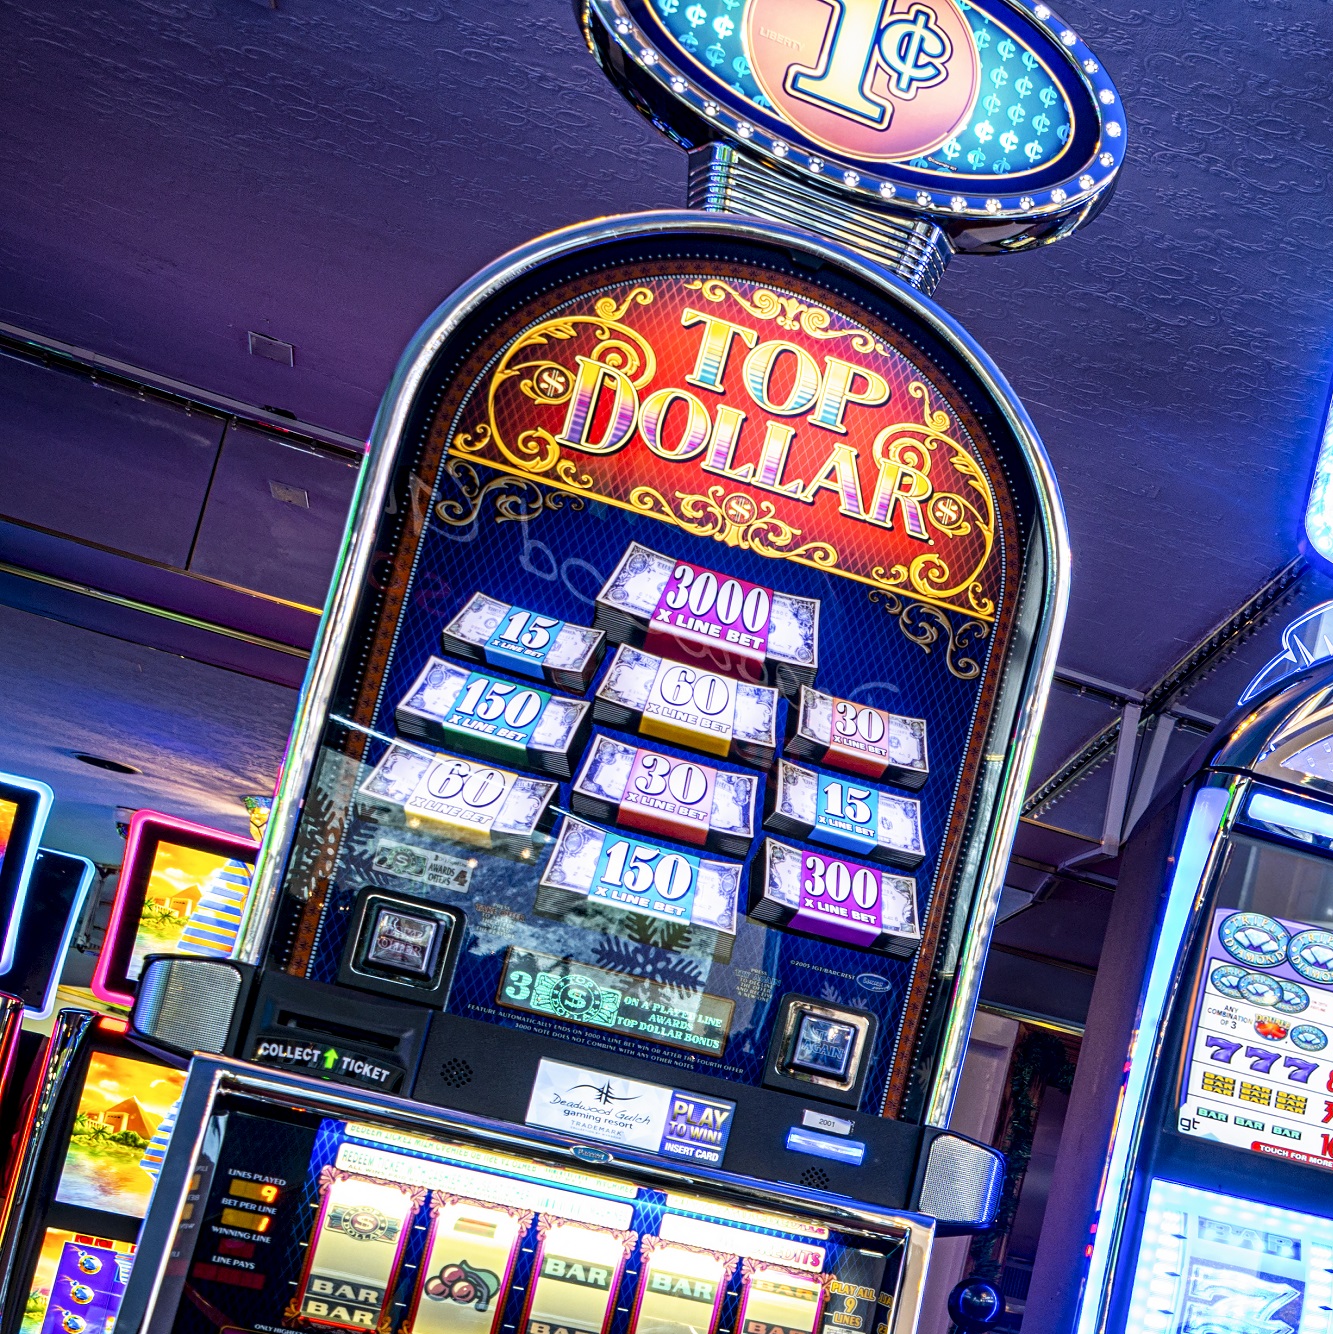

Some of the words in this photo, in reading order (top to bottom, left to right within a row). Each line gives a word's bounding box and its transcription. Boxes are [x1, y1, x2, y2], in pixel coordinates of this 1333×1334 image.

[681, 308, 890, 433] TOP
[555, 355, 933, 539] DOLLAR
[666, 564, 770, 632] 3000
[499, 611, 559, 649] 15
[655, 608, 669, 621] X
[675, 615, 720, 638] LINE
[725, 626, 764, 650] BET
[455, 678, 542, 728] 150
[660, 665, 728, 715] 60
[835, 702, 884, 742] 30
[427, 760, 505, 807] 60
[634, 754, 708, 803] 30
[823, 781, 871, 822] 15
[600, 840, 693, 899] 150
[804, 856, 879, 909] 300
[506, 970, 533, 1000] 3
[624, 997, 639, 1006] ON
[641, 1000, 649, 1009] A
[652, 1003, 698, 1022] PLAYED
[699, 1014, 722, 1028] LINE
[649, 1014, 693, 1031] AWARDS
[534, 1027, 550, 1035] NOTE
[552, 1031, 570, 1040] DOES
[571, 1035, 585, 1043] NOT
[587, 1039, 617, 1052] COMBINE
[618, 1046, 635, 1055] WITH
[636, 1050, 649, 1059] ANY
[650, 1054, 672, 1065] OTHER
[674, 1059, 694, 1070] NOTES
[618, 1017, 636, 1030] TOP
[638, 1021, 682, 1040] DOLLAR
[684, 1034, 720, 1049] BONUS
[260, 1043, 321, 1063] COLLECT
[342, 1056, 390, 1082] TICKET
[550, 1092, 613, 1116] Deadwood
[615, 1109, 651, 1125] Gulch
[563, 1108, 601, 1125] gaming
[604, 1118, 633, 1129] resort
[672, 1100, 729, 1130] PLAY
[819, 1119, 835, 1127] 2001
[571, 1120, 622, 1136] TRADEMARK
[669, 1121, 685, 1137] TO
[690, 1126, 722, 1144] WIN!
[664, 1143, 694, 1157] INSERT
[695, 1150, 719, 1161] CARD
[1260, 1144, 1288, 1157] TOUCH
[1290, 1152, 1307, 1161] FOR
[1309, 1157, 1333, 1168] MORE
[228, 1169, 252, 1179] LINES
[254, 1174, 286, 1186] PLAYED
[221, 1198, 237, 1206] BET
[239, 1201, 257, 1211] PER
[258, 1206, 277, 1215] LINE
[261, 1186, 278, 1202] 9
[211, 1226, 250, 1239] WINNING
[252, 1233, 271, 1243] LINE
[259, 1217, 270, 1232] 1
[212, 1256, 232, 1265] LINE
[233, 1259, 255, 1269] PAYS
